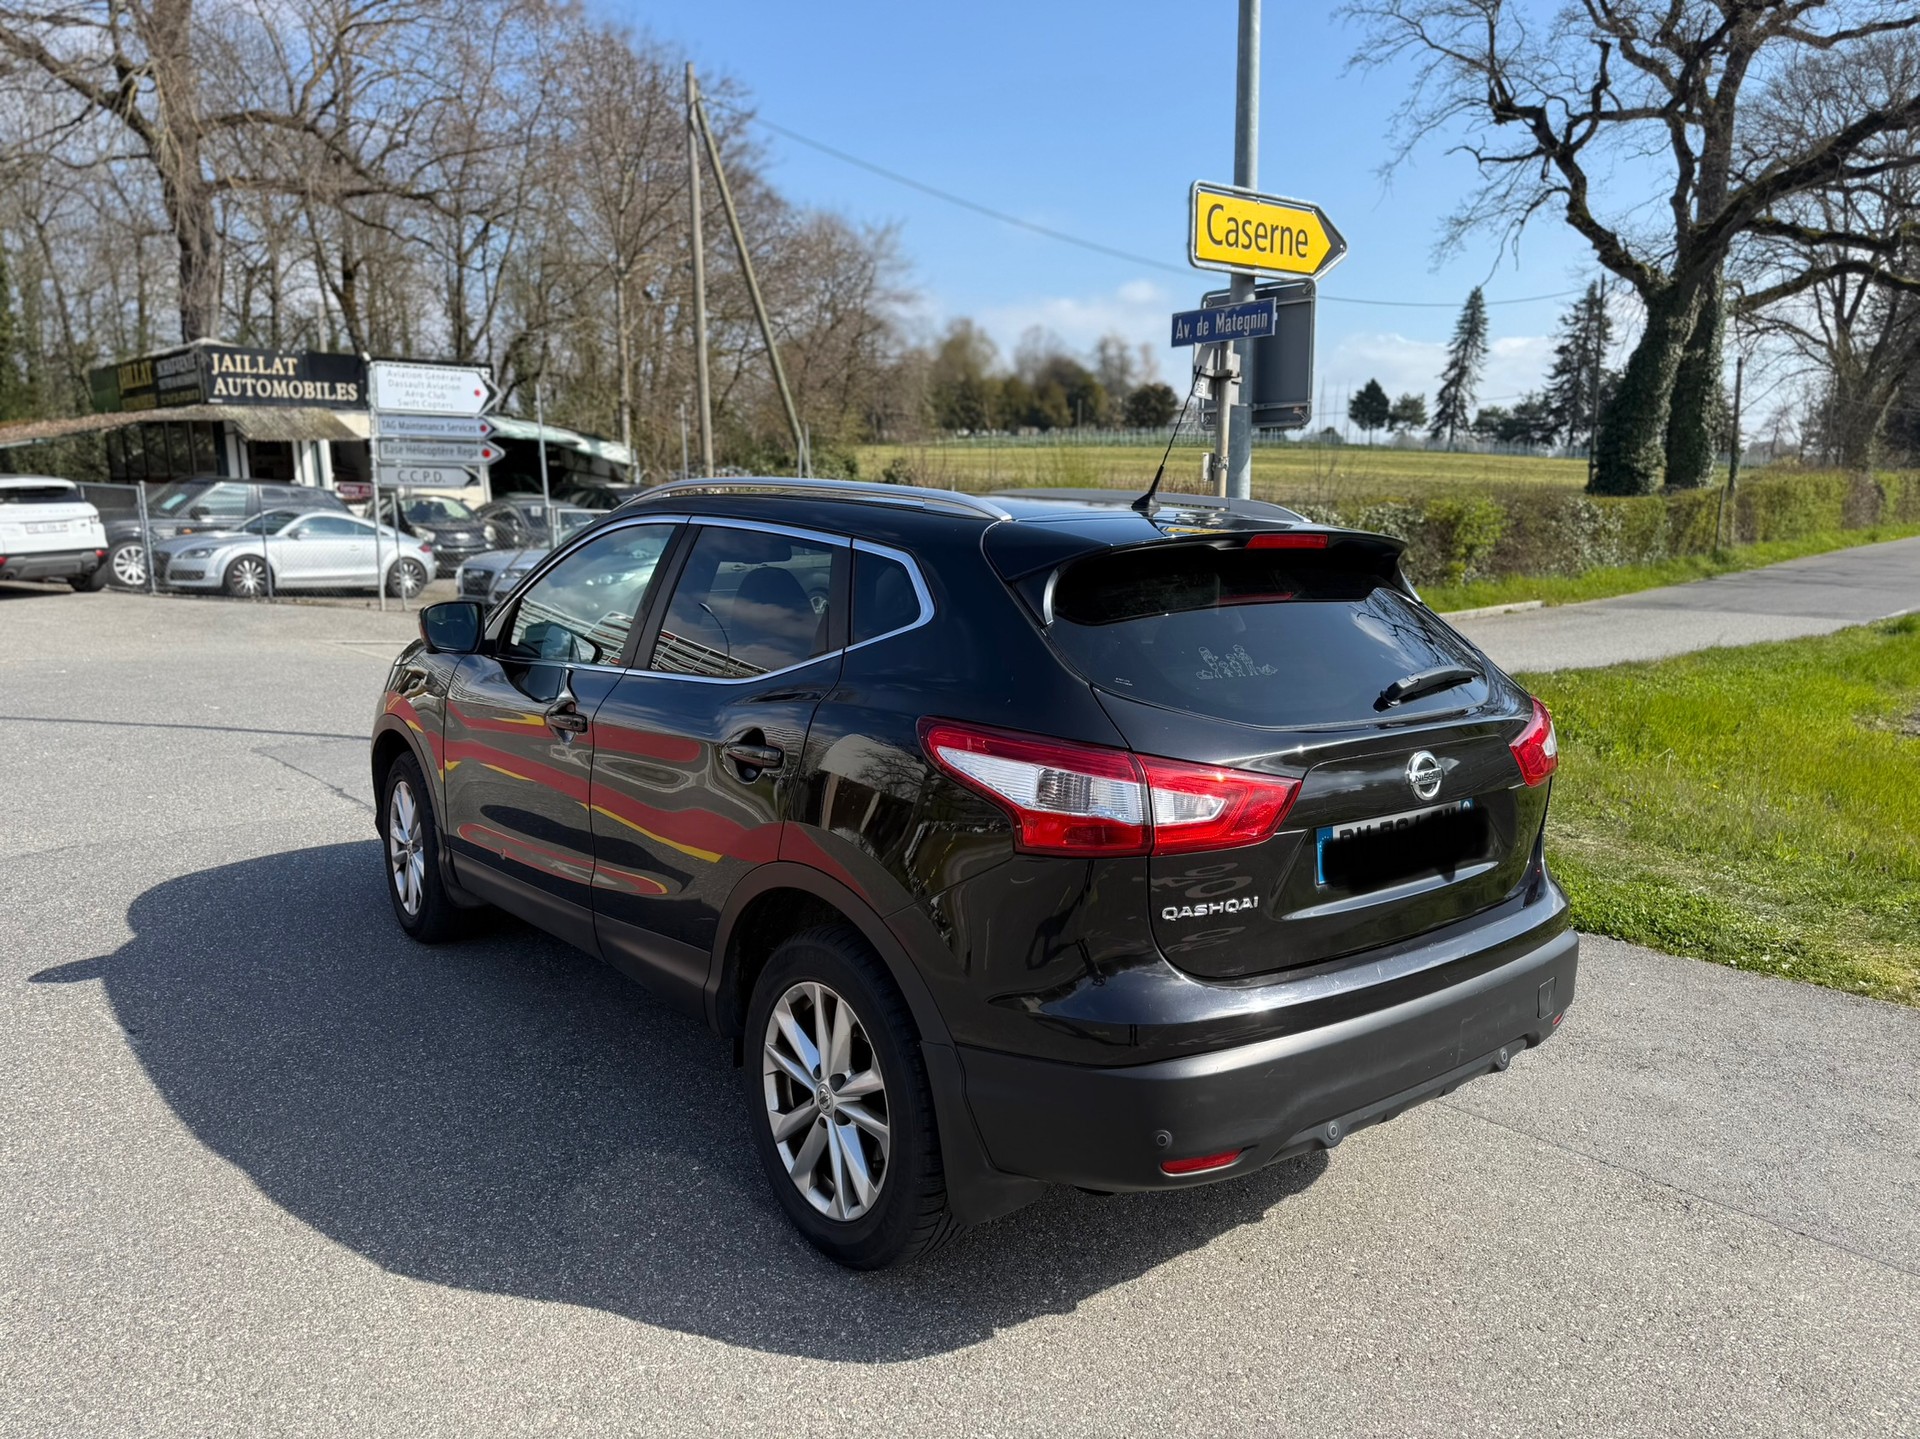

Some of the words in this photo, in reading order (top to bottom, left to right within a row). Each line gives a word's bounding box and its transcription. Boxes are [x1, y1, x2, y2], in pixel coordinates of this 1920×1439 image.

[1206, 203, 1309, 258] Caserne
[1175, 318, 1193, 340] Av.
[1196, 319, 1209, 336] de
[1215, 311, 1268, 335] Mategnin
[211, 353, 297, 376] JAILLAT
[386, 369, 423, 380] Aviation
[213, 377, 358, 401] AUTOMOBILES
[388, 379, 425, 389] Dassault
[426, 381, 461, 391] Aviation
[396, 398, 420, 408] Swift
[421, 400, 454, 410] Copters
[382, 420, 397, 430] TAG
[398, 421, 445, 431] Maintenance
[446, 422, 477, 433] Services
[383, 443, 404, 455] Base
[405, 444, 455, 457] Hélicoptère
[456, 445, 478, 459] Rega
[397, 469, 446, 483] C.C.P.D.
[1161, 895, 1259, 921] QASHQAI
